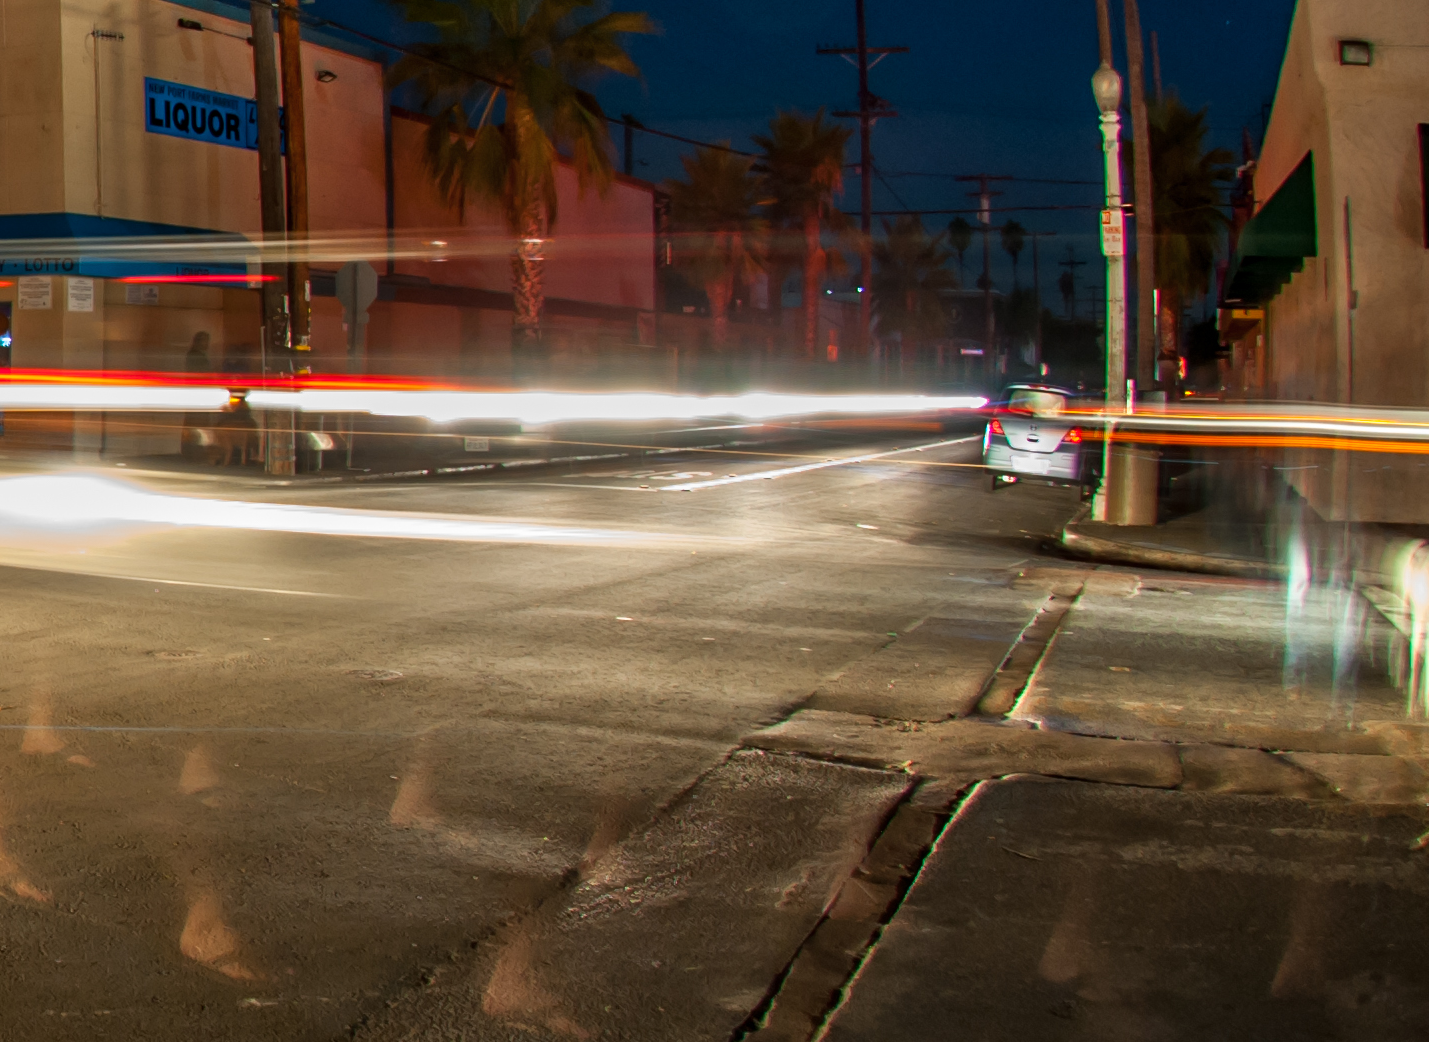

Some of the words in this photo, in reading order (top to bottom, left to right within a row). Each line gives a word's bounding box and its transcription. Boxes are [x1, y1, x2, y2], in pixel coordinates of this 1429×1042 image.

[148, 83, 165, 94] NEW
[167, 85, 186, 99] PORT
[188, 89, 211, 105] FARMS
[148, 97, 241, 142] LIQUOR
[24, 257, 75, 273] LOTTO
